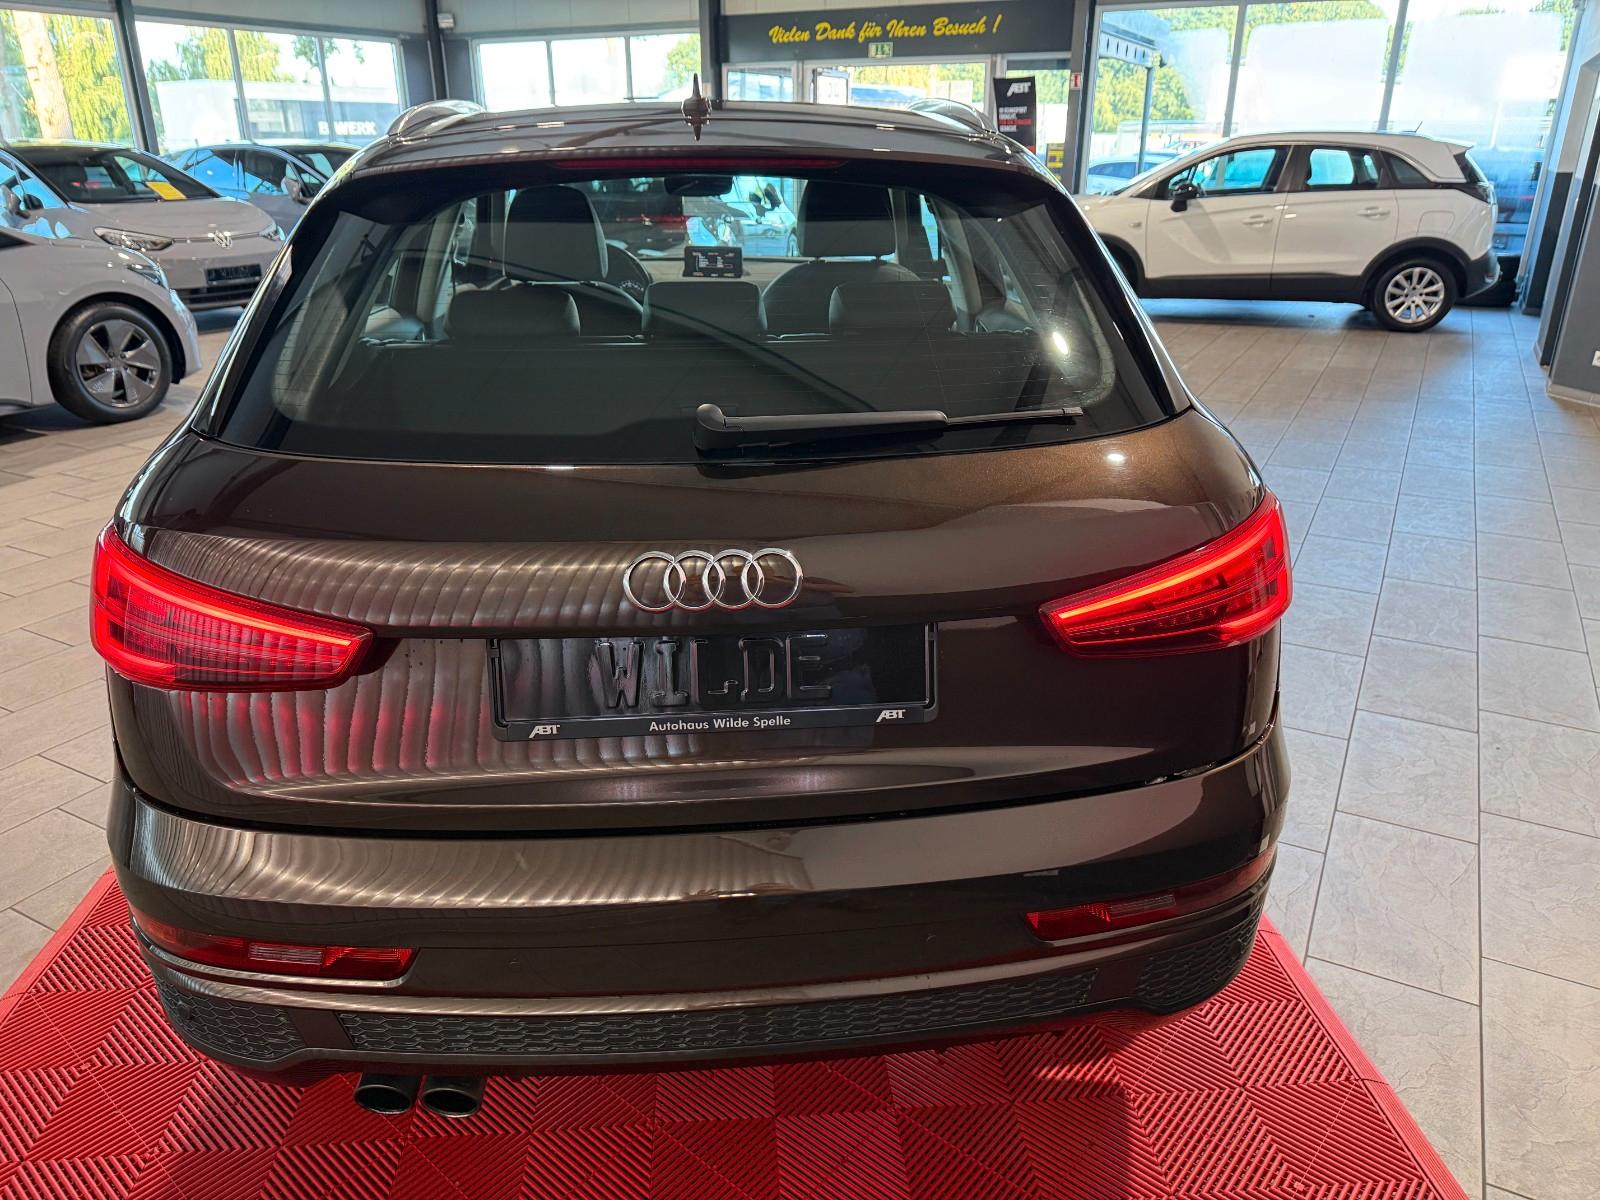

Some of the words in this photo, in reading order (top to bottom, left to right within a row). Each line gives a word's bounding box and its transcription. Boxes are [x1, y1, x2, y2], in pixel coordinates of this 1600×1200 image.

[768, 25, 811, 44] Vielen
[815, 21, 856, 41] Dank
[858, 20, 882, 43] für
[886, 18, 927, 38] Ihren
[933, 15, 987, 36] Besuch
[992, 13, 1003, 34] !
[1007, 81, 1032, 97] ABT
[318, 120, 377, 136] BWERK
[594, 633, 831, 710] WILDE
[529, 724, 560, 738] ABT
[649, 720, 710, 732] Autohaus
[712, 718, 750, 729] Wilde
[753, 715, 791, 729] Spelle
[875, 709, 906, 723] ABT
